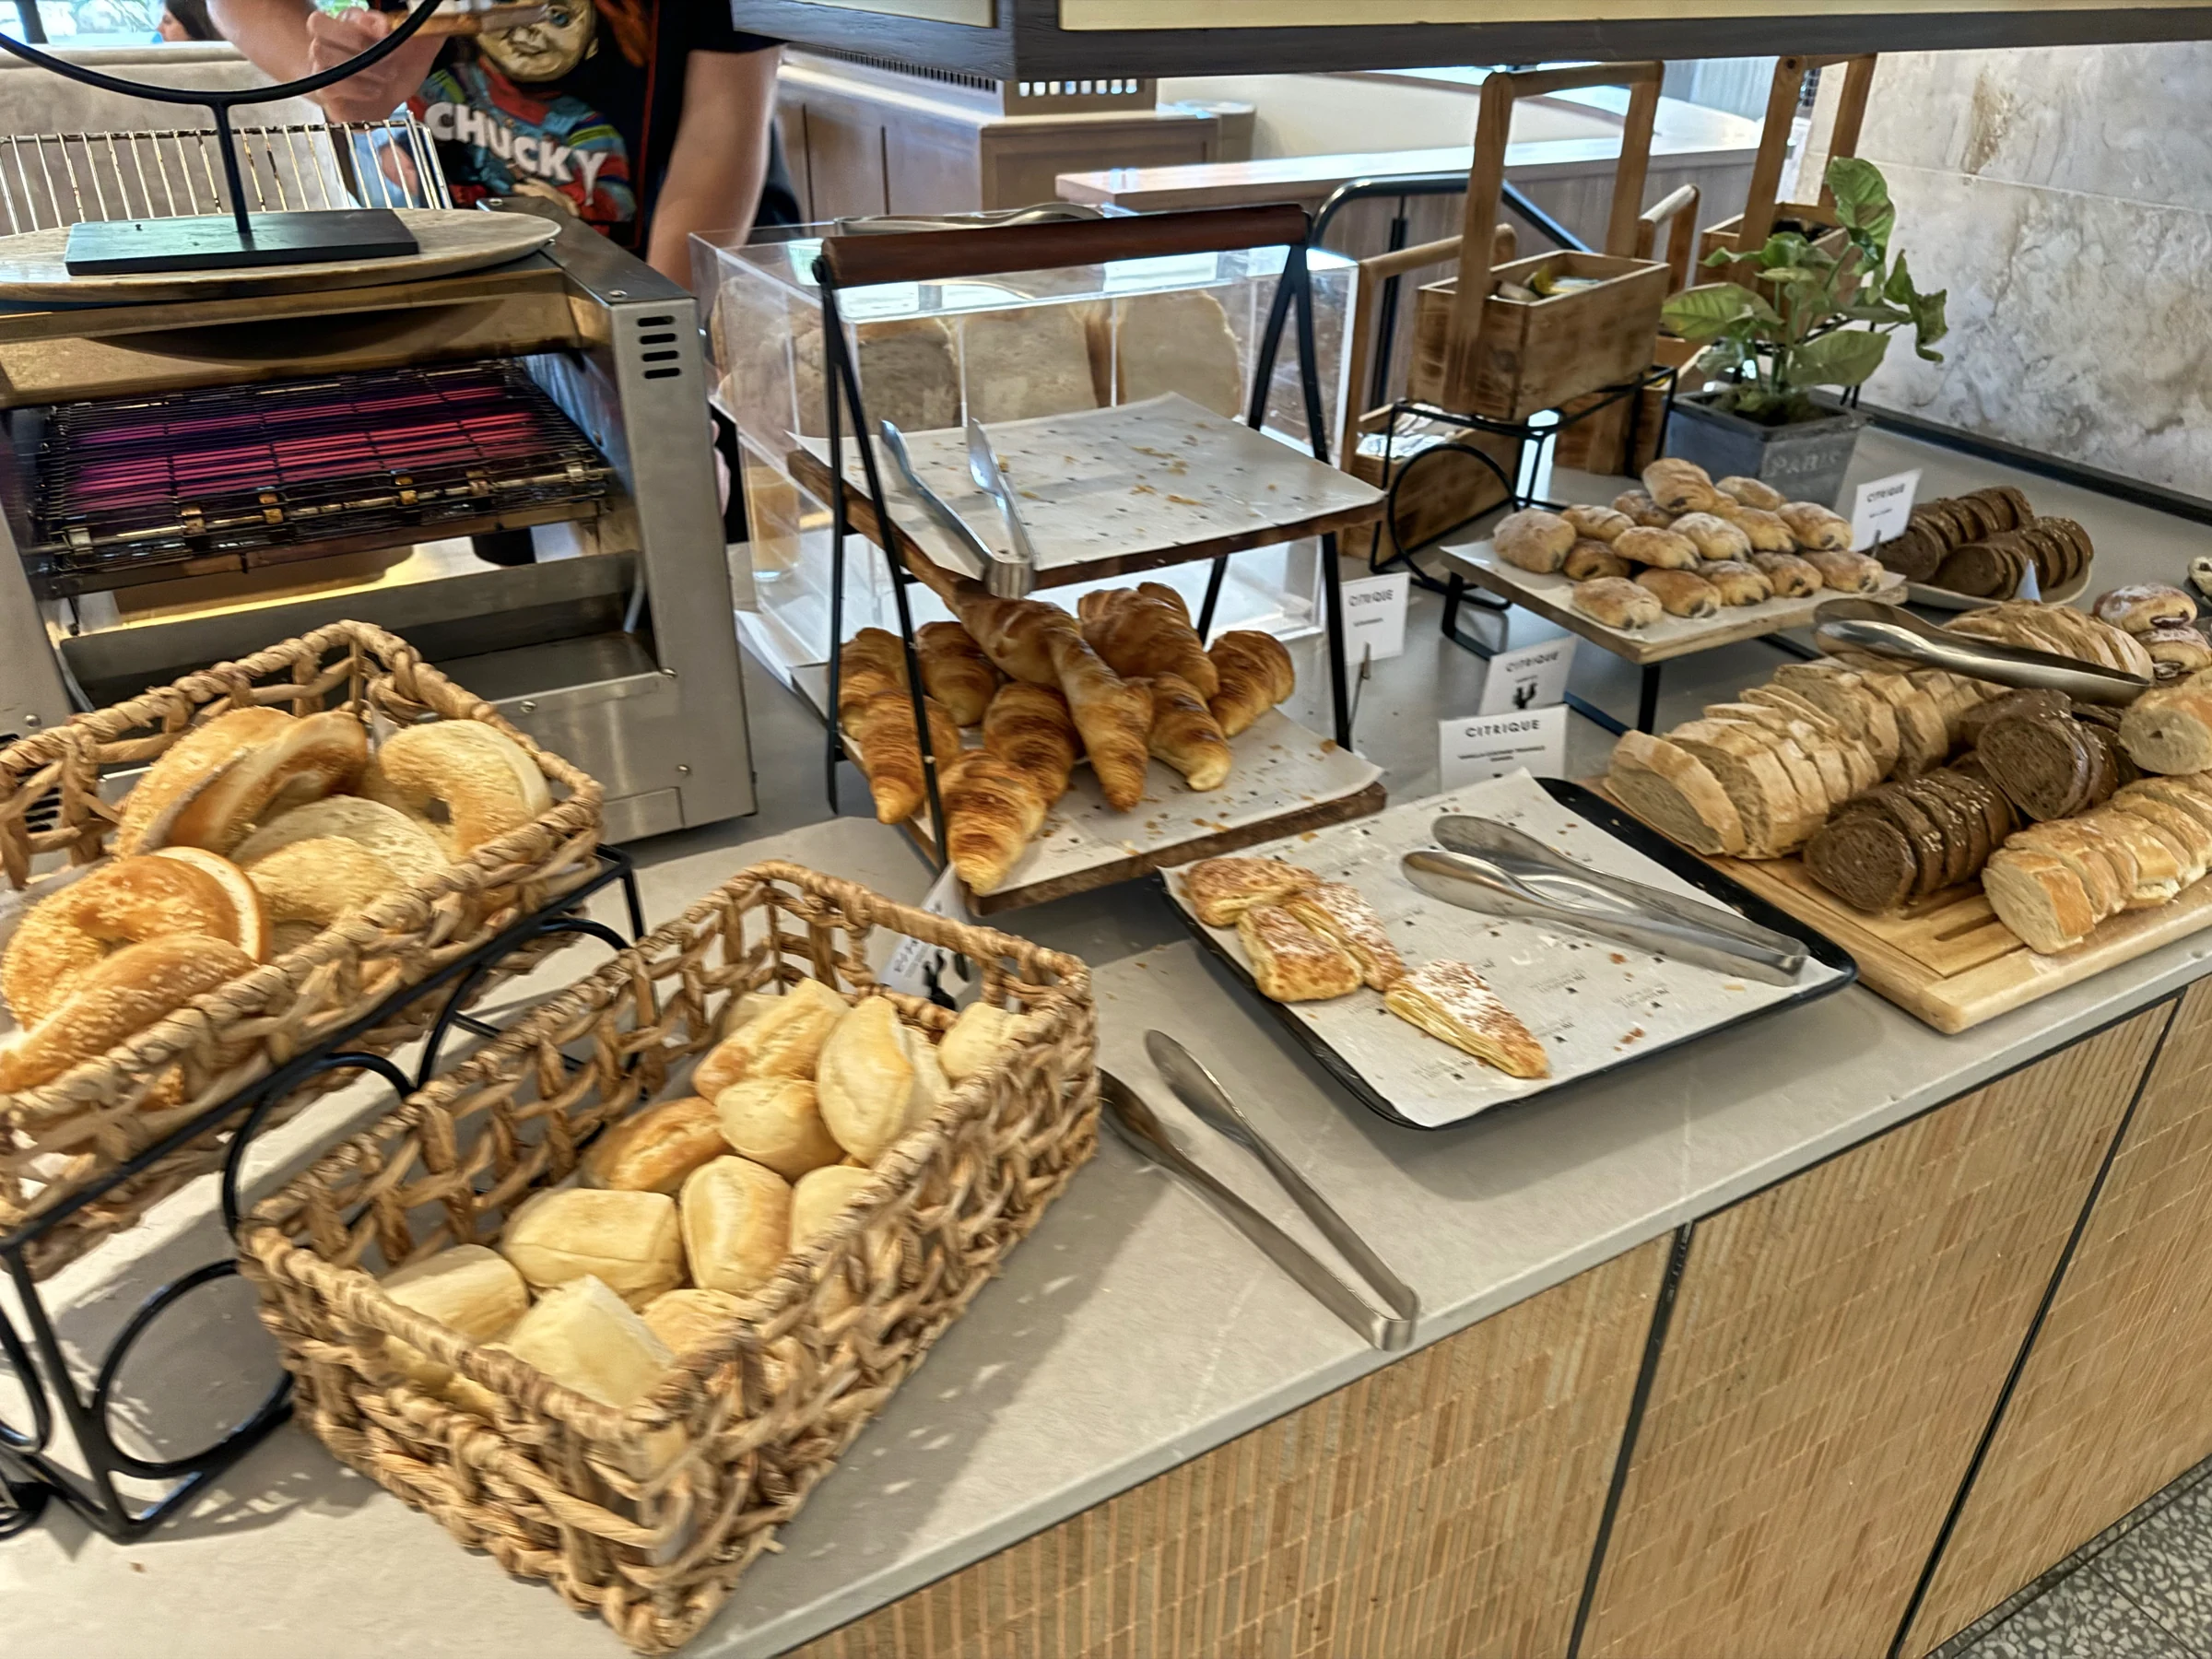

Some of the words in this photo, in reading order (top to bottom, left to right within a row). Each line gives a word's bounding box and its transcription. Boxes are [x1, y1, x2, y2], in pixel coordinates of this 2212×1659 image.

[424, 101, 607, 206] CHUCKY
[1348, 589, 1394, 606] CITRIQUE
[1505, 651, 1559, 672] CITRIQUE
[1465, 719, 1540, 737] CITRIQUE
